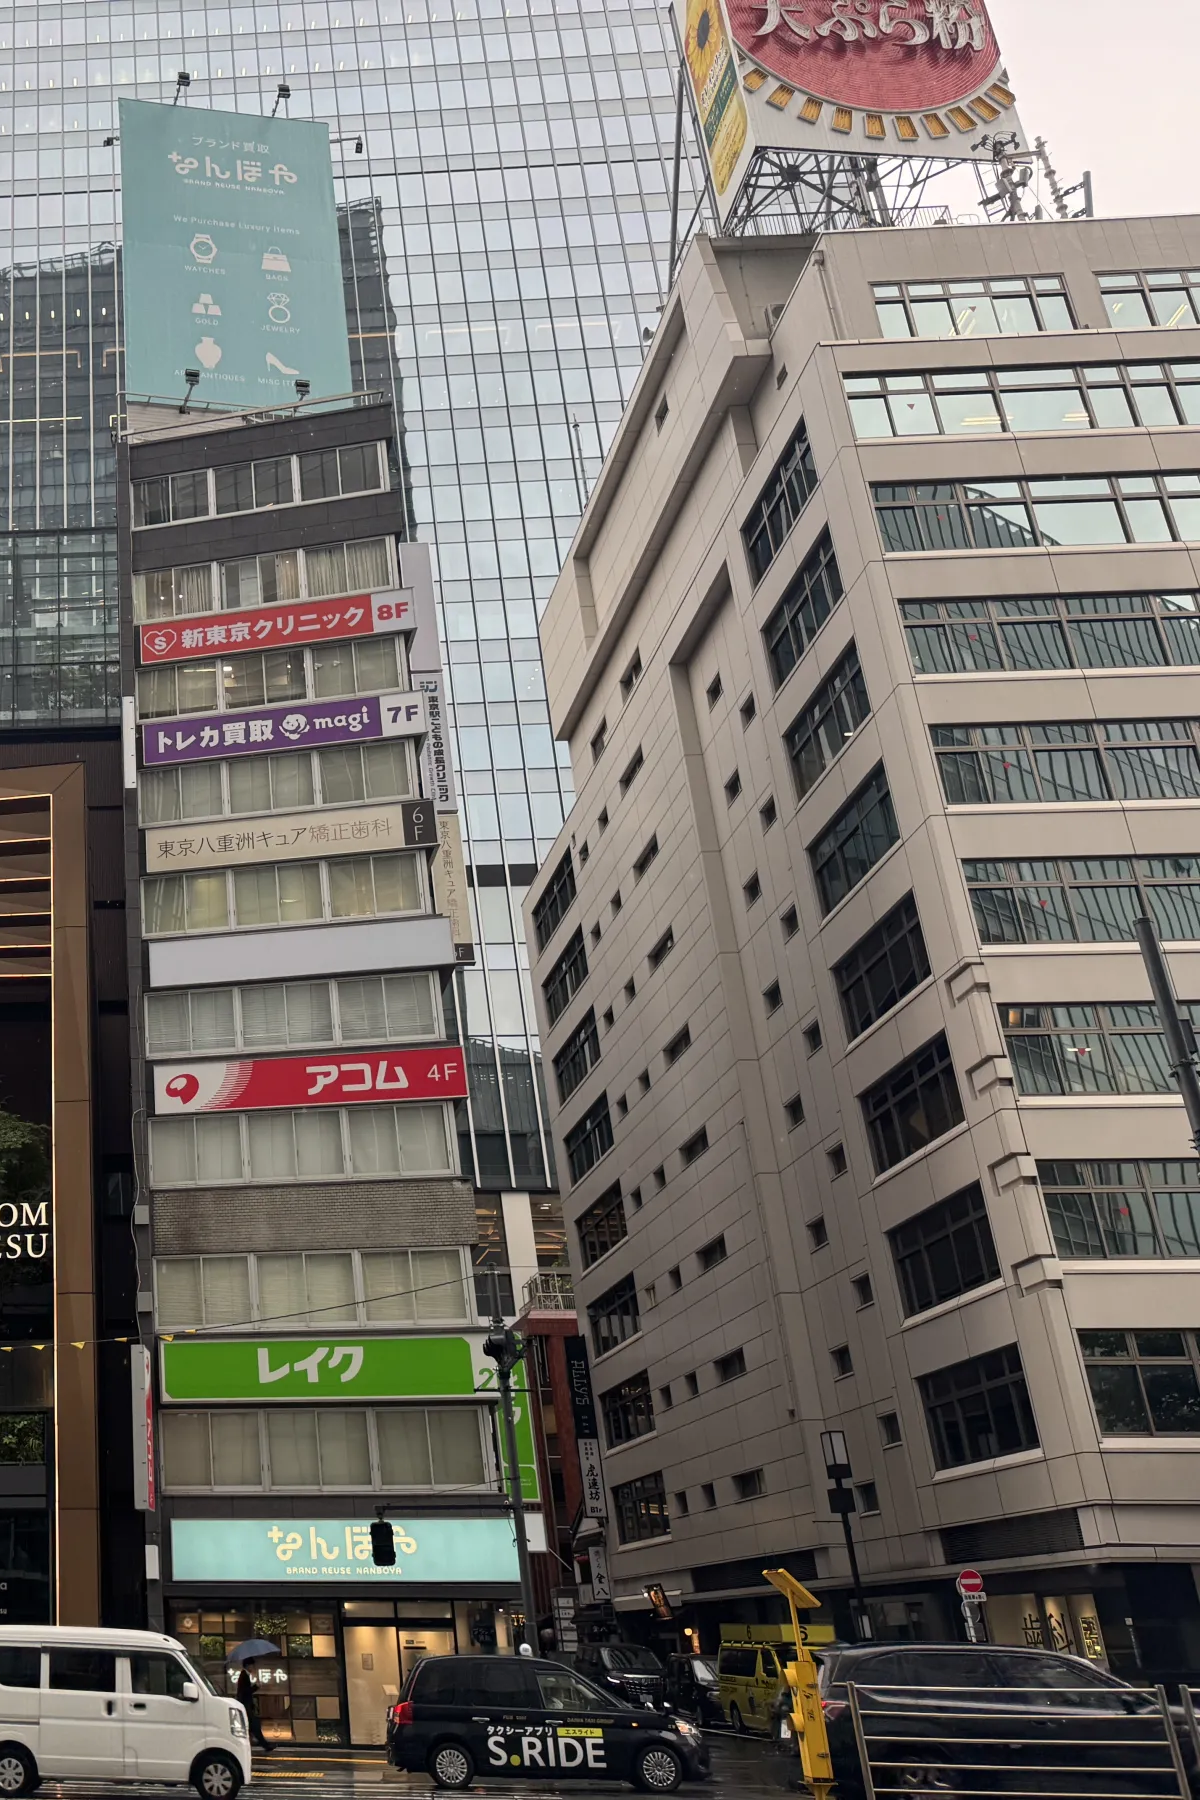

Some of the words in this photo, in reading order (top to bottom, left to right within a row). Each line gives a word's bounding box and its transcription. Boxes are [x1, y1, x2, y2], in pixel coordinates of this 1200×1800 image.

[191, 136, 270, 154] ブランド買取
[183, 178, 212, 187] BRAND
[215, 181, 241, 191] REUSE
[245, 185, 285, 195] NANBOYA
[173, 214, 188, 223] We
[191, 216, 236, 228] Purchase
[238, 222, 271, 233] Luxury
[184, 265, 226, 275] WATCHES
[265, 274, 289, 282] BAGS
[195, 317, 219, 326] GOLD
[260, 325, 300, 334] JEWELRY
[257, 377, 280, 386] MISC
[181, 606, 365, 649] 新東京クリニック
[376, 602, 409, 621] 8F
[158, 718, 274, 754] トレカ買取
[313, 705, 371, 732] magi
[387, 704, 419, 724] 7F
[157, 817, 393, 860] 東京八重洲キュア矯正歯科
[412, 806, 425, 841] 6F
[306, 1060, 409, 1096] アコム
[427, 1063, 457, 1082] 4F
[257, 1346, 364, 1384] レイク
[286, 1566, 318, 1575] BRAND
[321, 1566, 351, 1575] REUSE
[356, 1566, 402, 1575] NANBOYA
[486, 1726, 553, 1736] タクシーアプリ
[487, 1736, 607, 1769] S.RIDE
